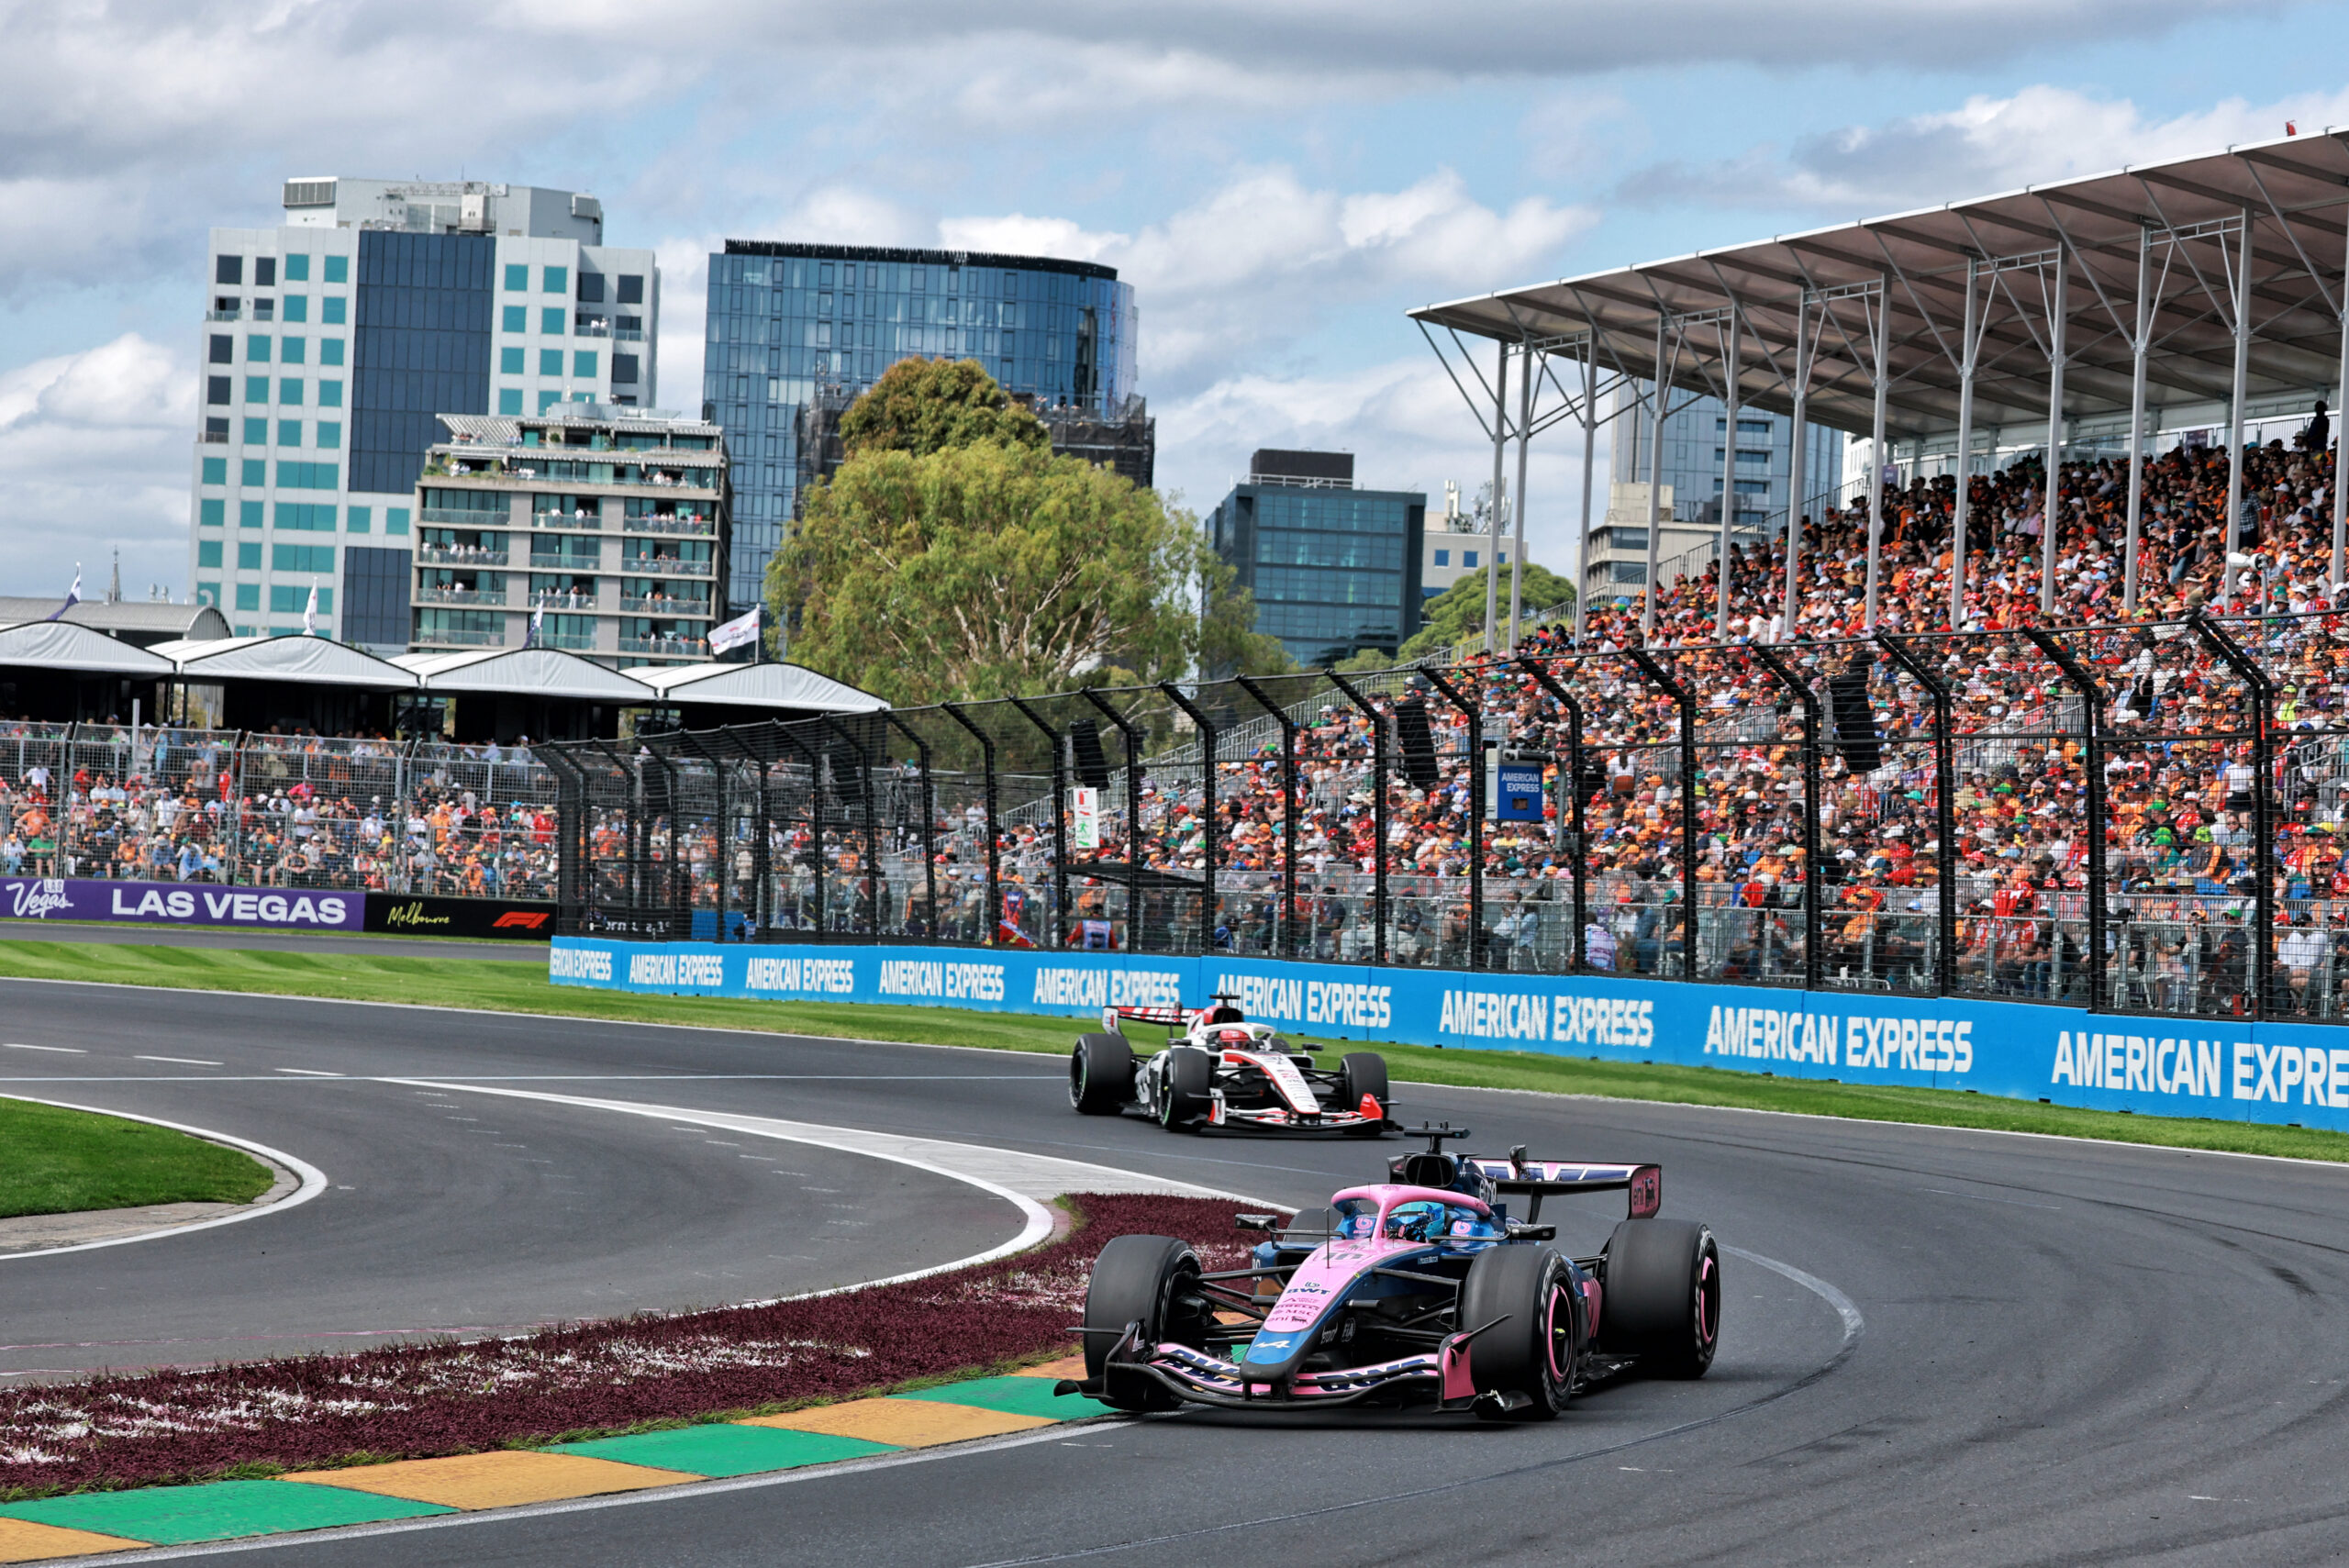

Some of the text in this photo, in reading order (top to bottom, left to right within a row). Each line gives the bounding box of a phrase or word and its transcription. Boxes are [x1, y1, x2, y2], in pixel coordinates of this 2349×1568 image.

[1501, 773, 1540, 783] AMERICAN
[1507, 783, 1540, 793] EXPRESS
[6, 881, 74, 919] Vegas
[46, 881, 62, 892] LAS
[112, 888, 347, 925] LAS VEGAS
[387, 901, 451, 928] Melbourne
[574, 949, 612, 982] EXPRESS
[629, 954, 723, 986] AMERICAN EXPRESS
[745, 957, 854, 994] AMERICAN EXPRESS
[878, 960, 1005, 1001] AMERICAN EXPRESS
[1033, 967, 1181, 1008] AMERICAN EXPRESS
[1214, 973, 1392, 1029] AMERICAN EXPRESS
[1438, 989, 1653, 1048] AMERICAN EXPRESS
[1703, 1005, 1974, 1073] AMERICAN EXPRESS
[2051, 1030, 2221, 1097] AMERICAN
[1286, 1287, 1330, 1296] BWT
